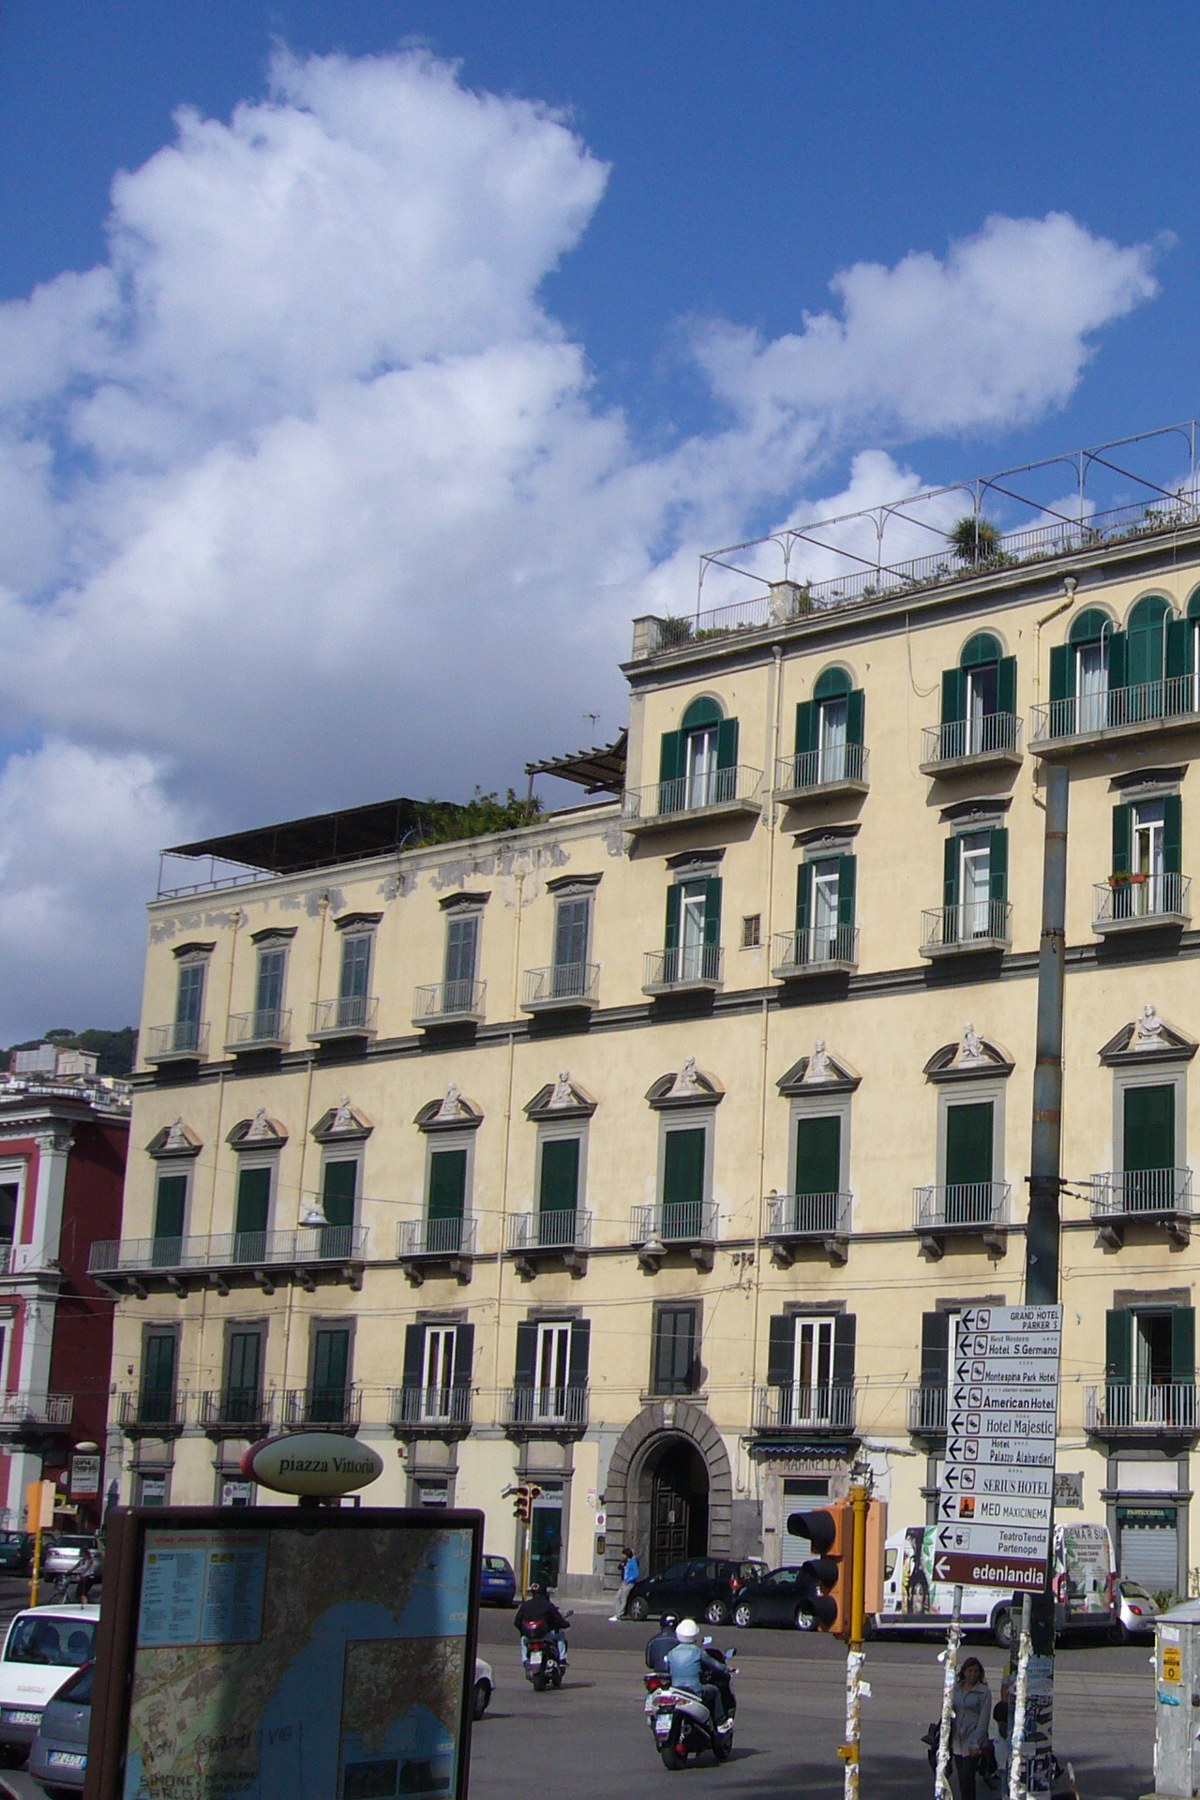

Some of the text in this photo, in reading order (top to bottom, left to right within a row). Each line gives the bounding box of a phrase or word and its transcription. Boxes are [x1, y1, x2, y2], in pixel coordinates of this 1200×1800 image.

[1010, 1311, 1059, 1320] GRAND HOTEL
[989, 1344, 1010, 1354] Hotel
[985, 1371, 1056, 1382] Montespina Park Hotel
[983, 1395, 1054, 1409] American Hotel
[986, 1419, 1053, 1437] Hotel Majestic
[991, 1438, 1010, 1448] Hotel
[989, 1449, 1014, 1462] Palazzo
[279, 1455, 375, 1475] piazza Vittoria
[783, 1459, 842, 1472] MARINELLA
[983, 1478, 1050, 1496] SERIUS HOTEL
[981, 1502, 1048, 1520] MED MAXICINEMA
[997, 1542, 1038, 1556] Partenope
[972, 1563, 1044, 1585] edenlandia
